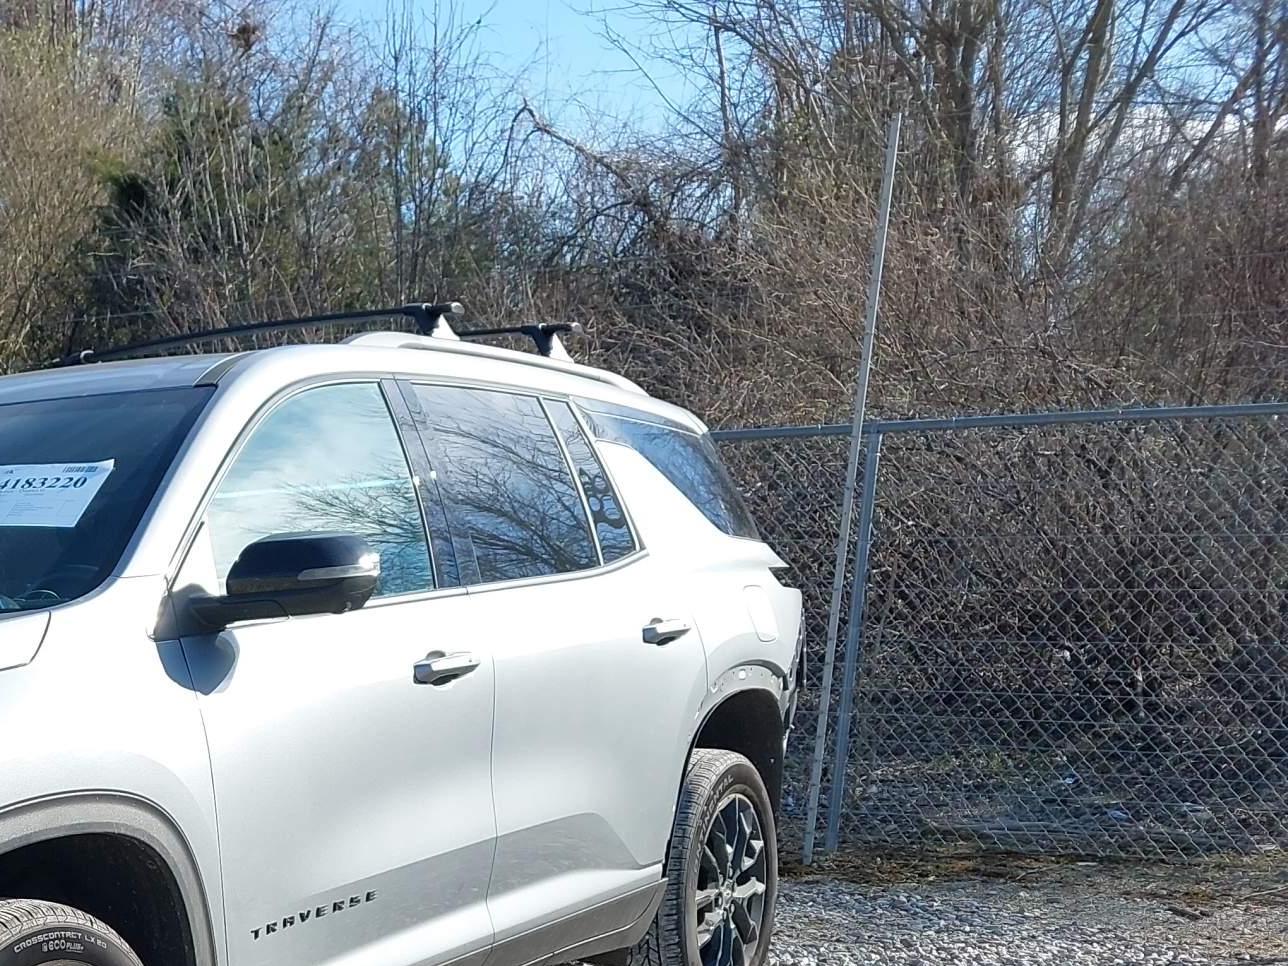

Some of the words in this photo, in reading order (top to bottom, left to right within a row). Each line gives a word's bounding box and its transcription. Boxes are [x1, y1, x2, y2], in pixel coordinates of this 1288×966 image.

[250, 890, 378, 940] TRAVERSE
[14, 931, 83, 953] CROSSCONTACT
[84, 935, 96, 944] LX
